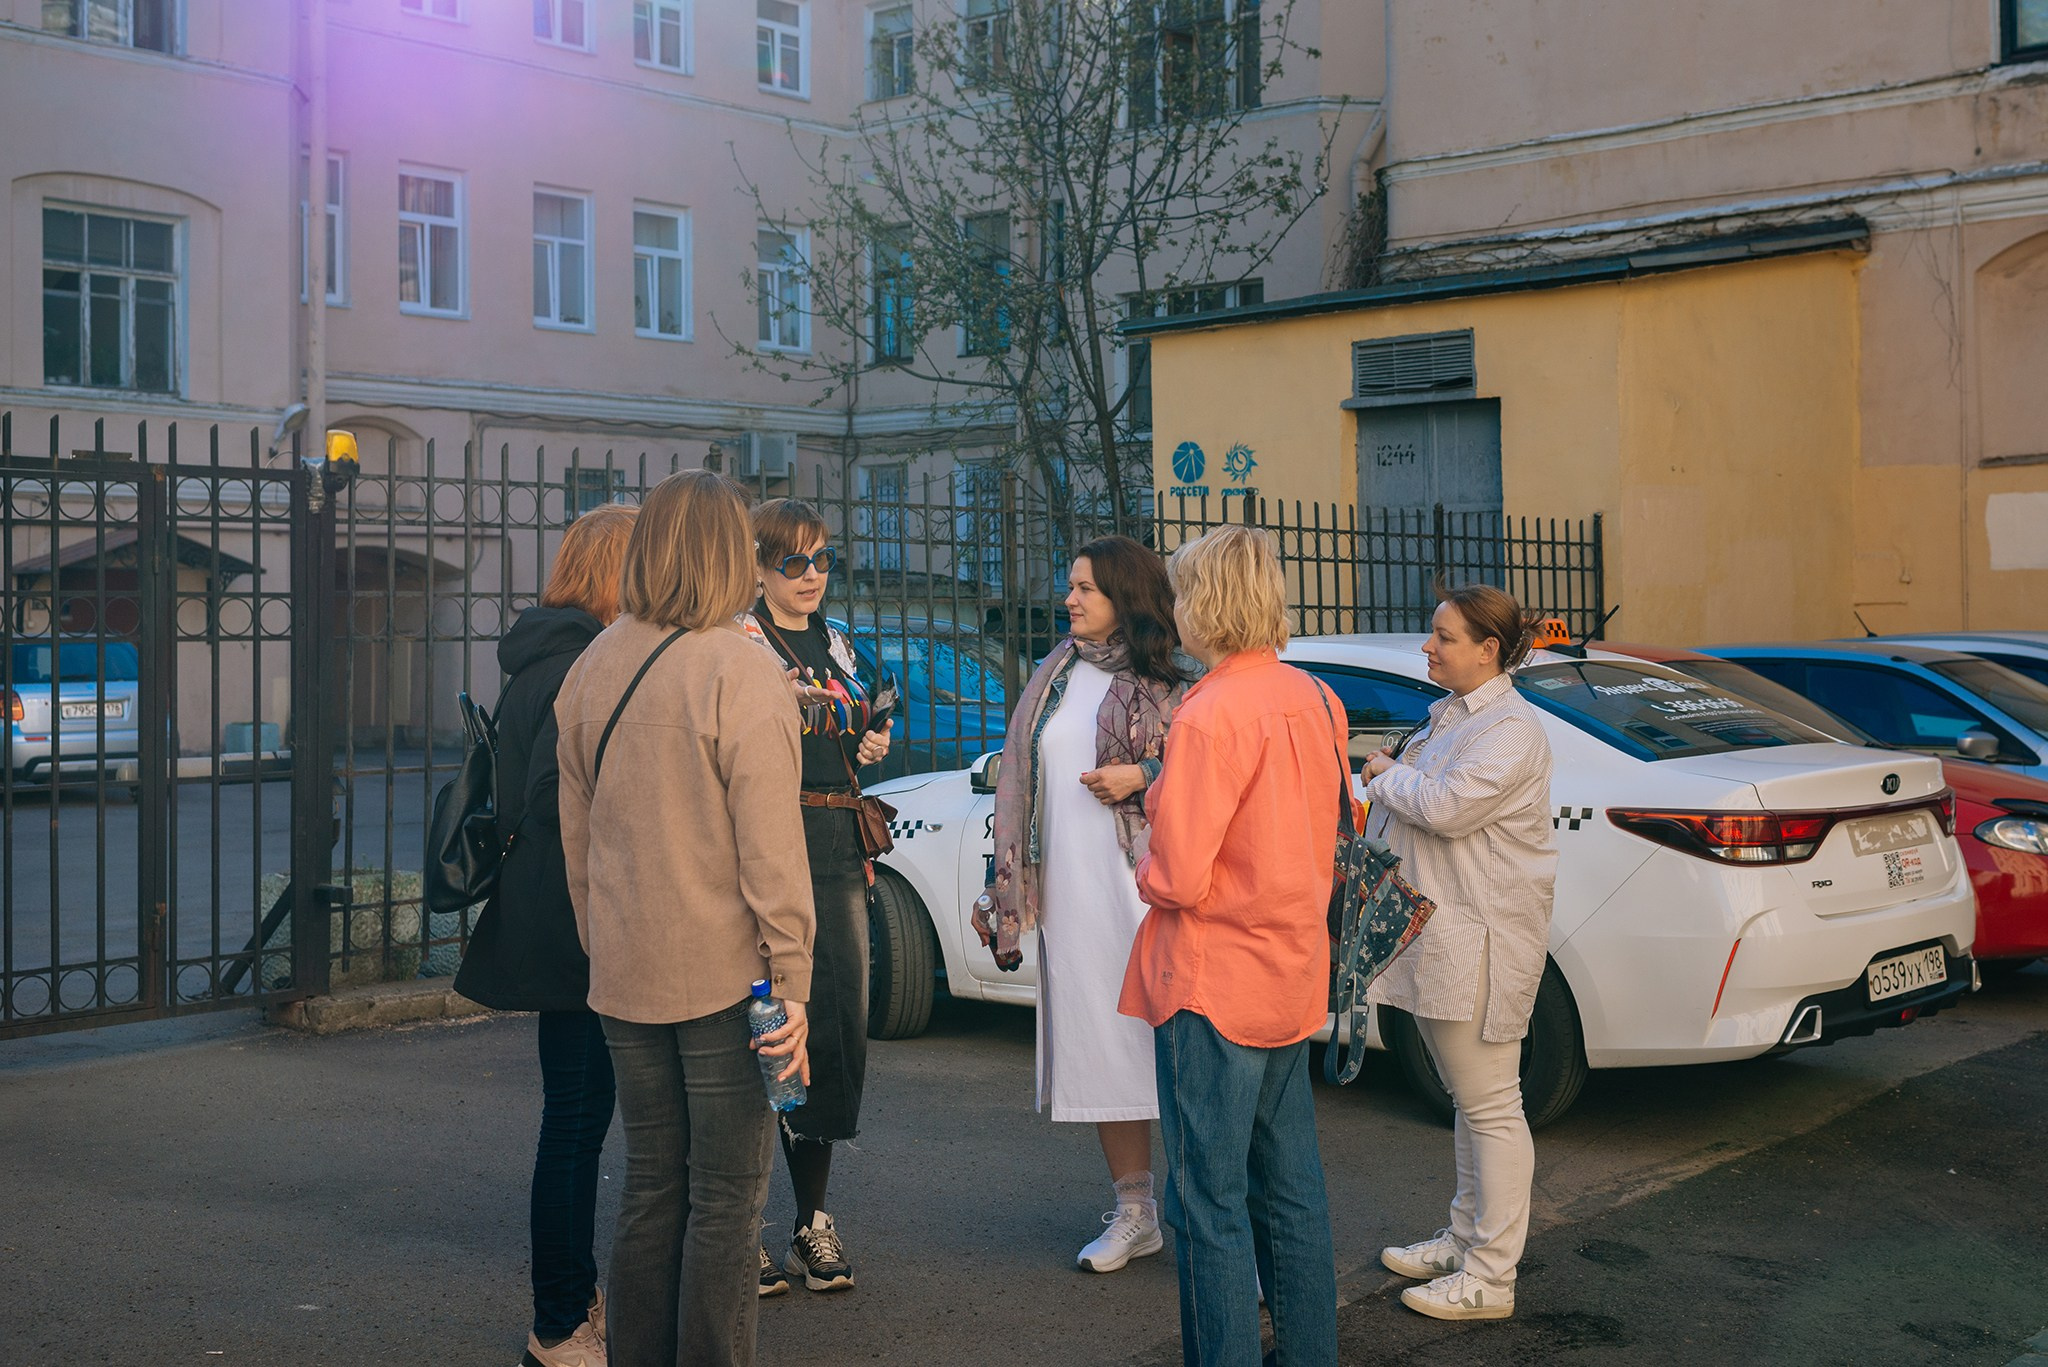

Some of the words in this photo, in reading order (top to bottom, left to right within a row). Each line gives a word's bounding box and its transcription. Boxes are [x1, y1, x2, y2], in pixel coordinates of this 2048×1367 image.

[1377, 444, 1415, 466] 1244
[1170, 486, 1209, 497] РОССЕТИ
[1811, 879, 1833, 889] RIO
